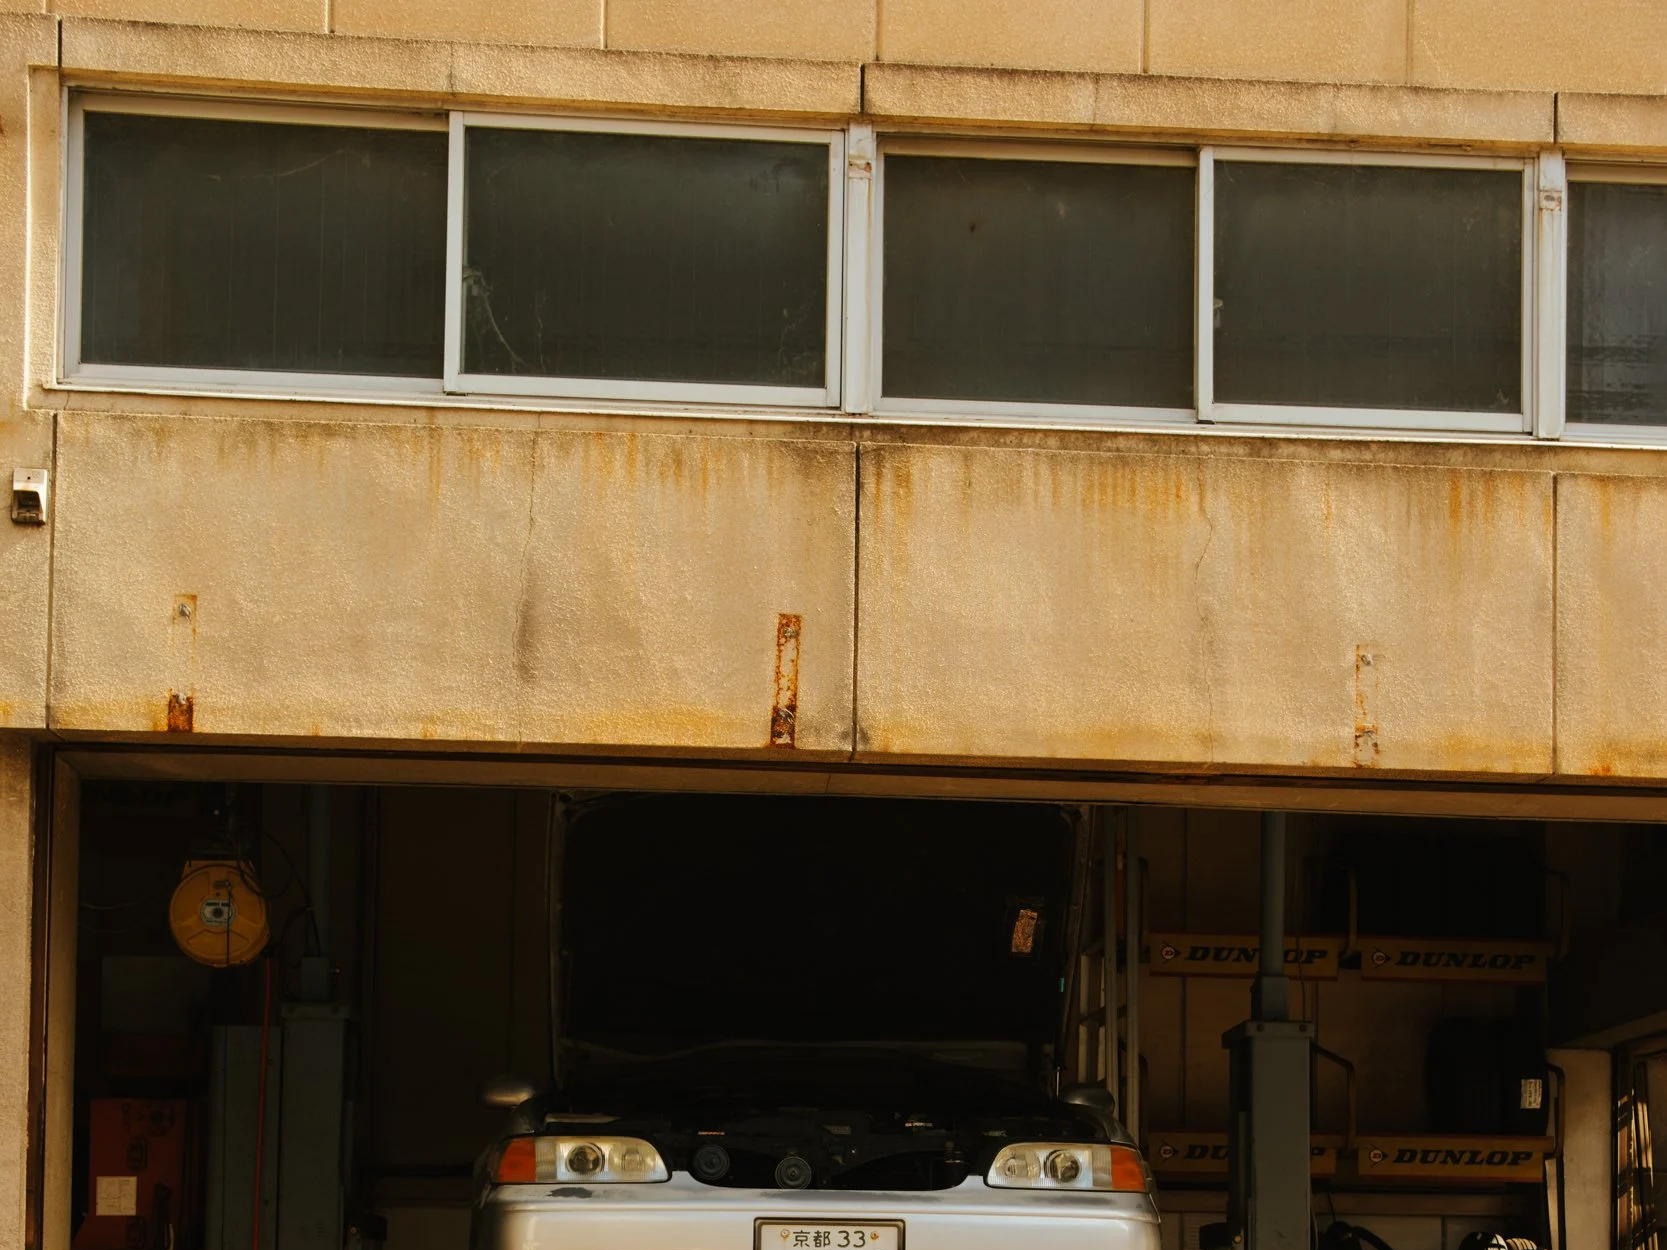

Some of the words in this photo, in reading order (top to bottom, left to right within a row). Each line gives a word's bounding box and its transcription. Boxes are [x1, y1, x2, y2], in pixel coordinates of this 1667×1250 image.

[1184, 945, 1328, 964] DUNOP
[1394, 951, 1537, 970] DUNLOP
[1183, 1144, 1327, 1161] DUP
[1392, 1149, 1533, 1166] DUNLOP
[792, 1229, 831, 1248] 京都
[837, 1230, 866, 1248] 33
